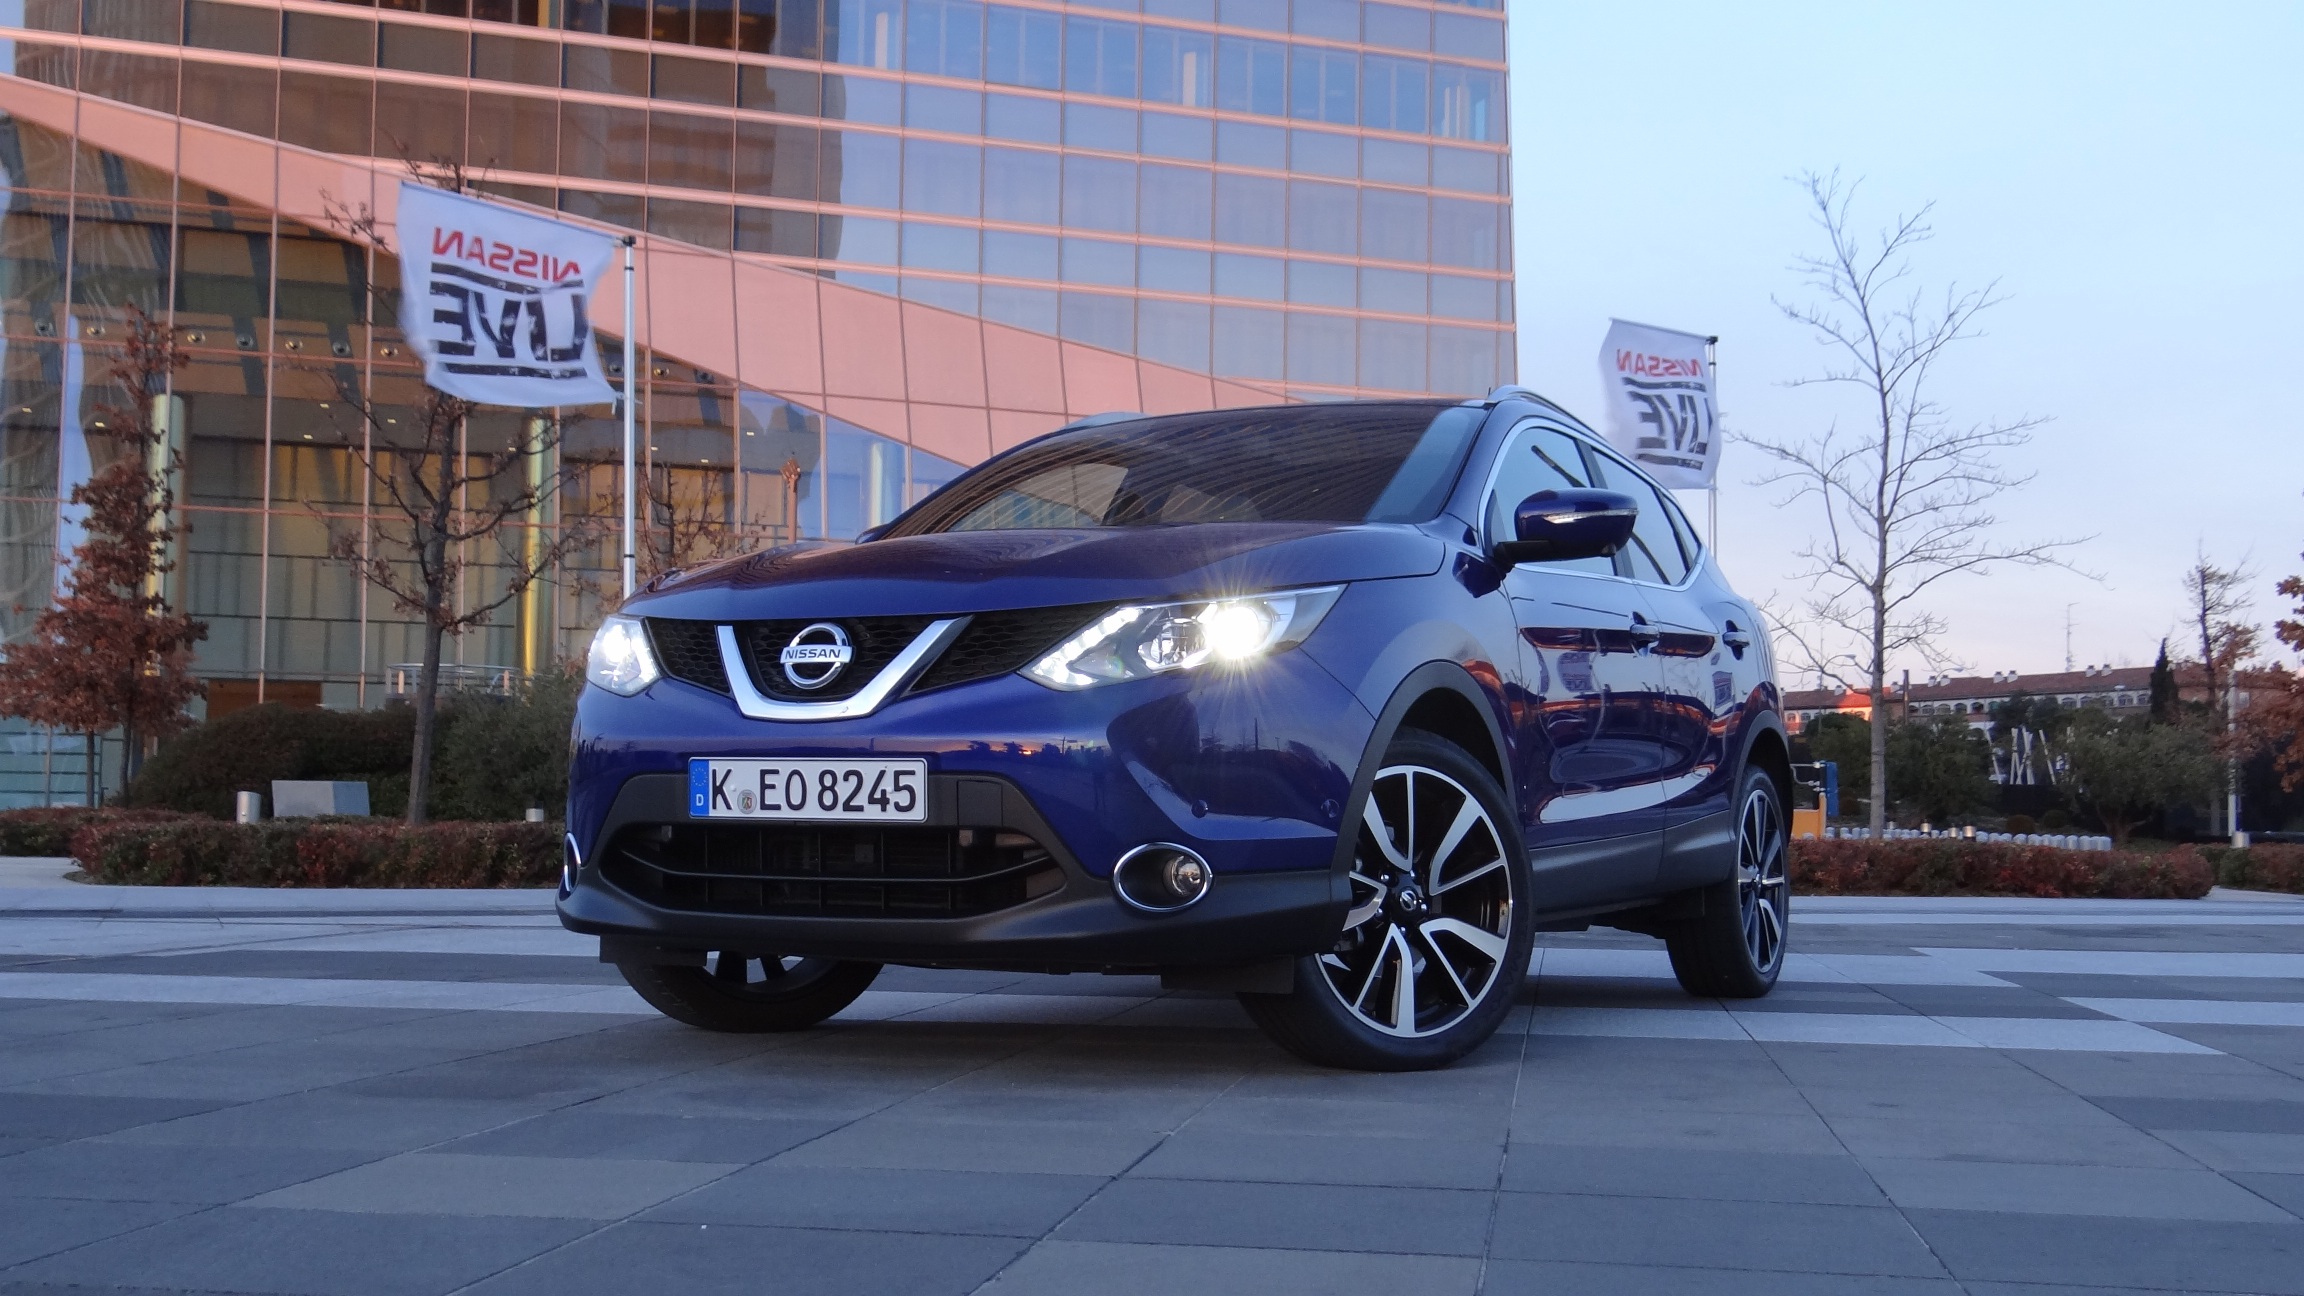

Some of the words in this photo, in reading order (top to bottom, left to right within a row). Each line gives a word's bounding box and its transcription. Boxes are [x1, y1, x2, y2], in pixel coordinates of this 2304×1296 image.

[784, 648, 841, 661] NISSAN
[711, 768, 733, 811] K
[817, 769, 917, 813] 8245
[695, 794, 704, 807] D
